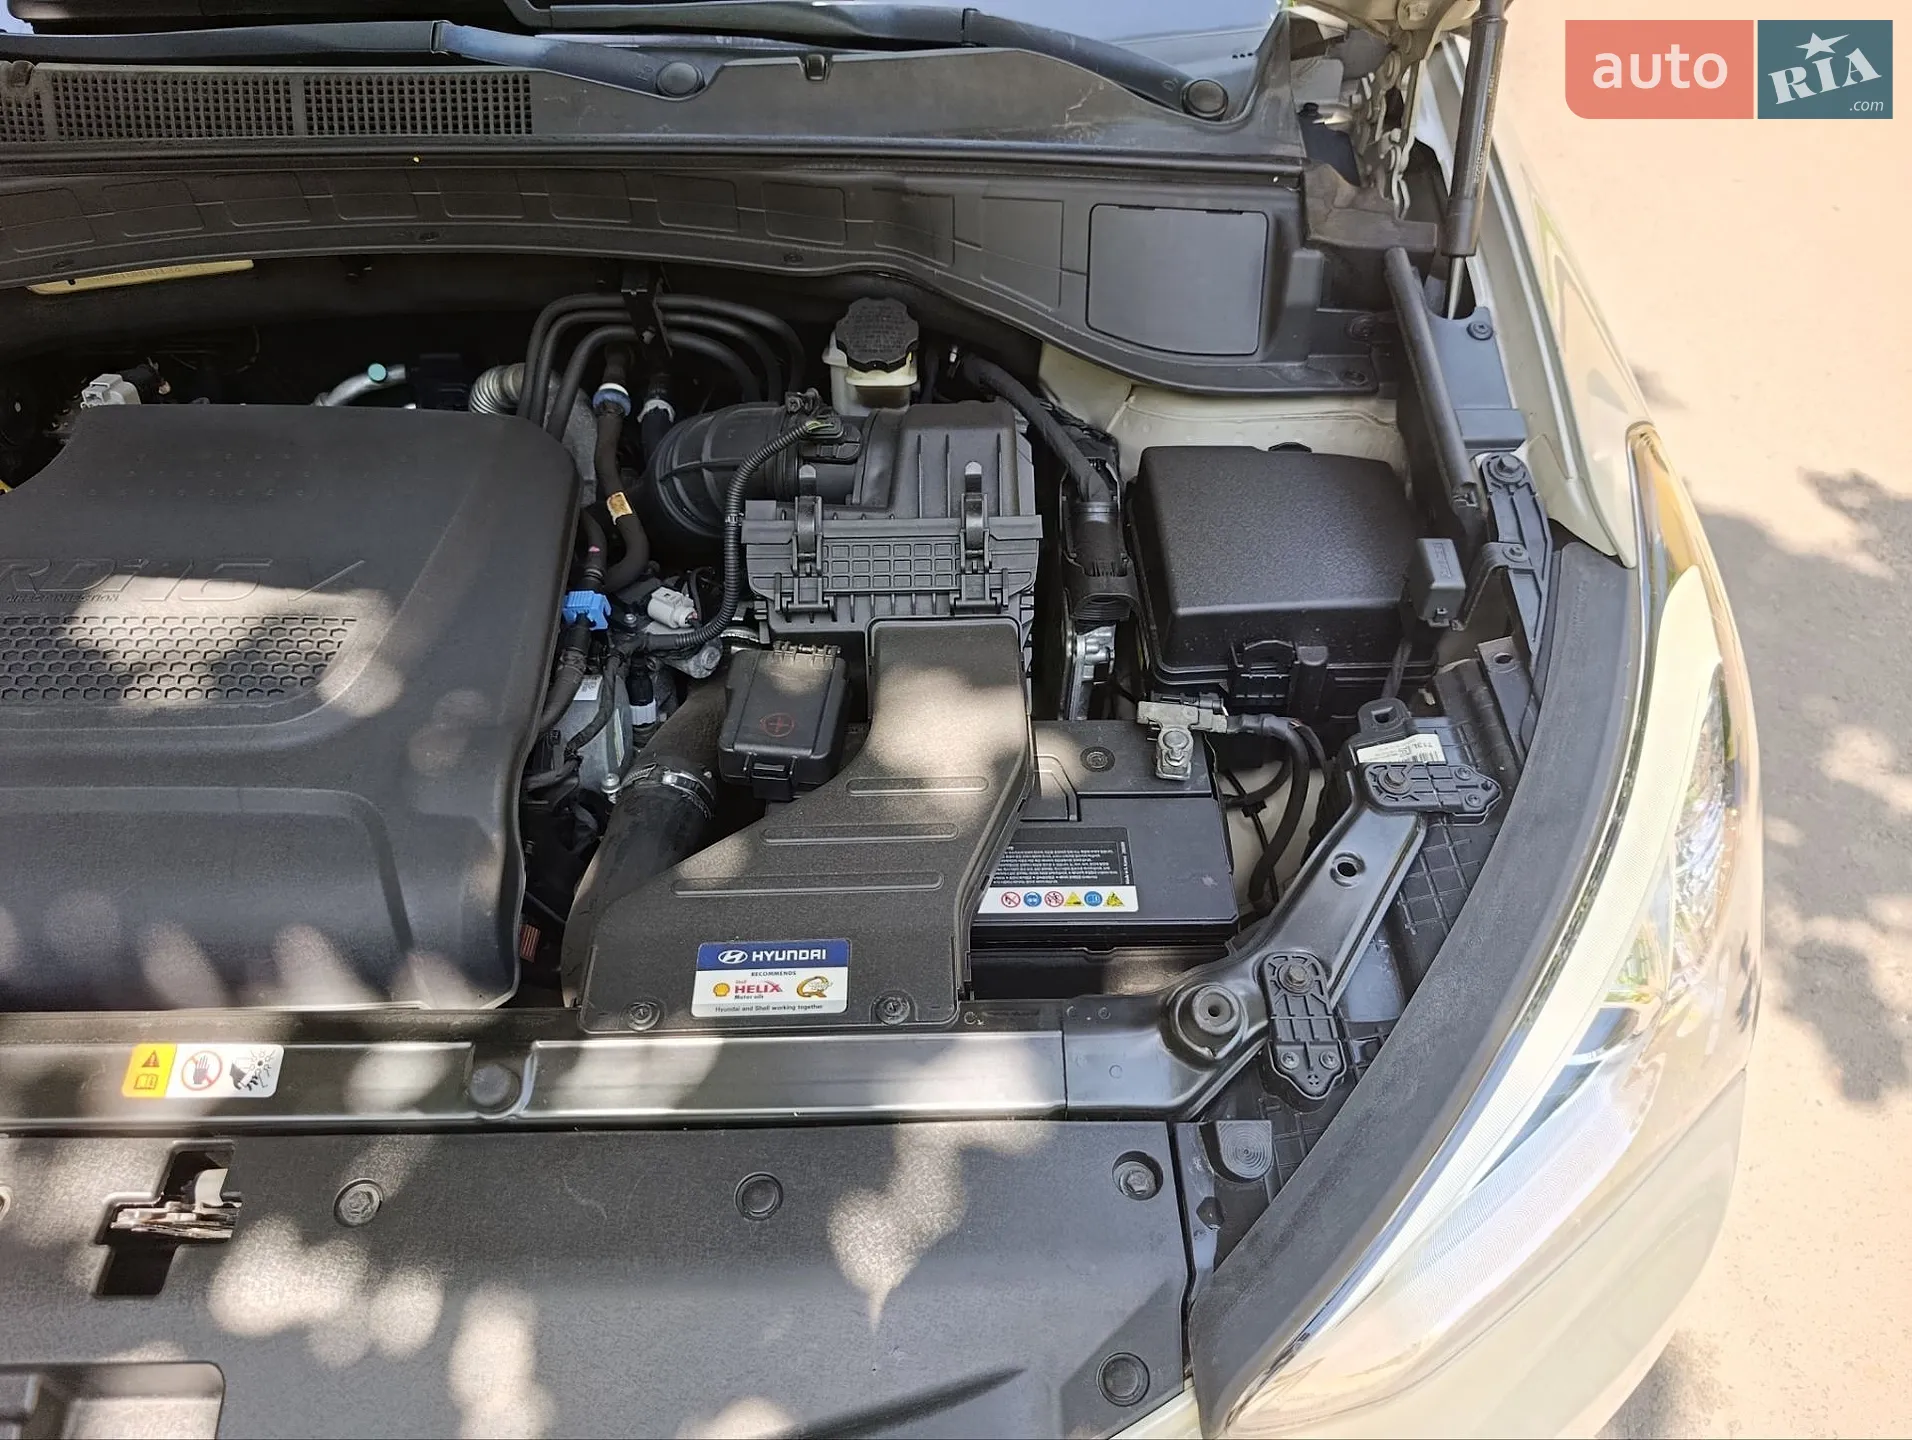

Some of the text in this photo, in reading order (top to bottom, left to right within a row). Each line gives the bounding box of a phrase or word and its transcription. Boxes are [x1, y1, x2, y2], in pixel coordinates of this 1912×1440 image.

[752, 949, 826, 962] HYUNDAI
[734, 981, 783, 994] HELIX
[715, 1005, 740, 1013] Hyundai
[771, 1004, 796, 1012] working
[797, 1003, 823, 1011] together
